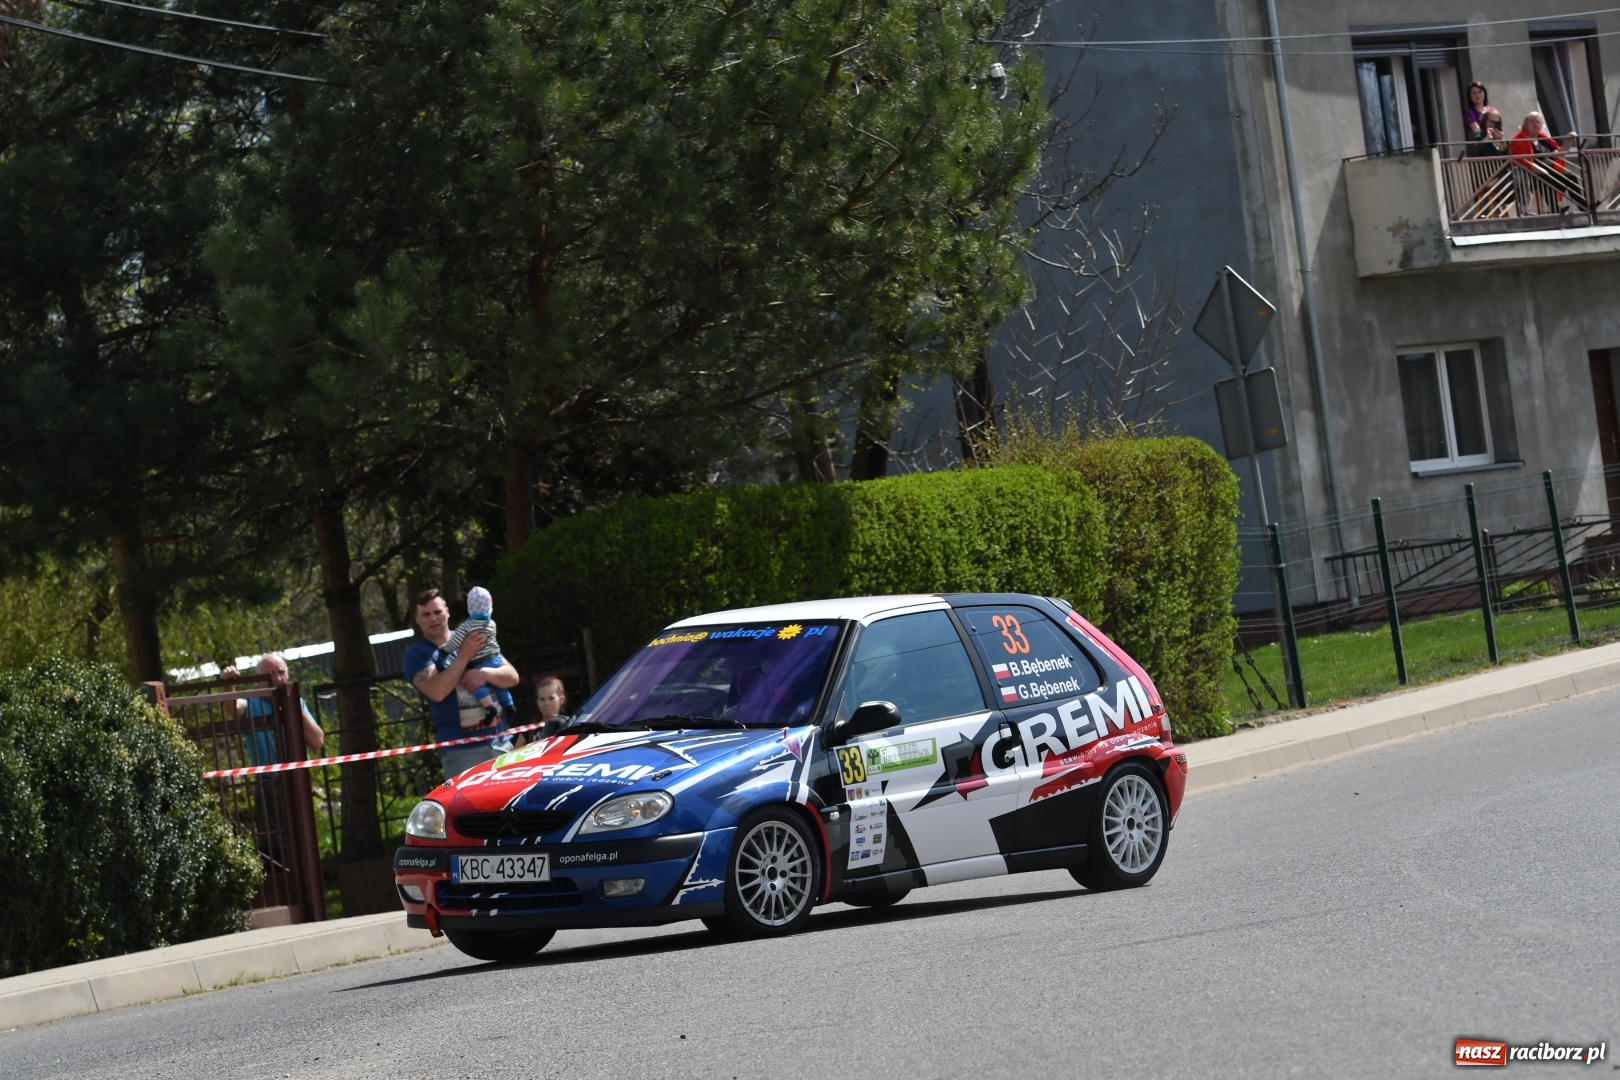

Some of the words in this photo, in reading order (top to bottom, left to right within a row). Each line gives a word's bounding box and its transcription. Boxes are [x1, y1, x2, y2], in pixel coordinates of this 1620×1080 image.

[709, 626, 775, 640] wakacje
[992, 614, 1030, 655] 33
[1009, 654, 1072, 677] B.Bębenek
[1018, 676, 1080, 700] G.Bębenek
[981, 675, 1154, 778] GREMI
[496, 763, 655, 780] GREMI
[838, 746, 865, 785] 33
[398, 857, 437, 868] oponafelga.pl
[460, 858, 490, 881] KBC
[496, 856, 546, 879] 43347
[559, 851, 618, 864] oponafelga.pl
